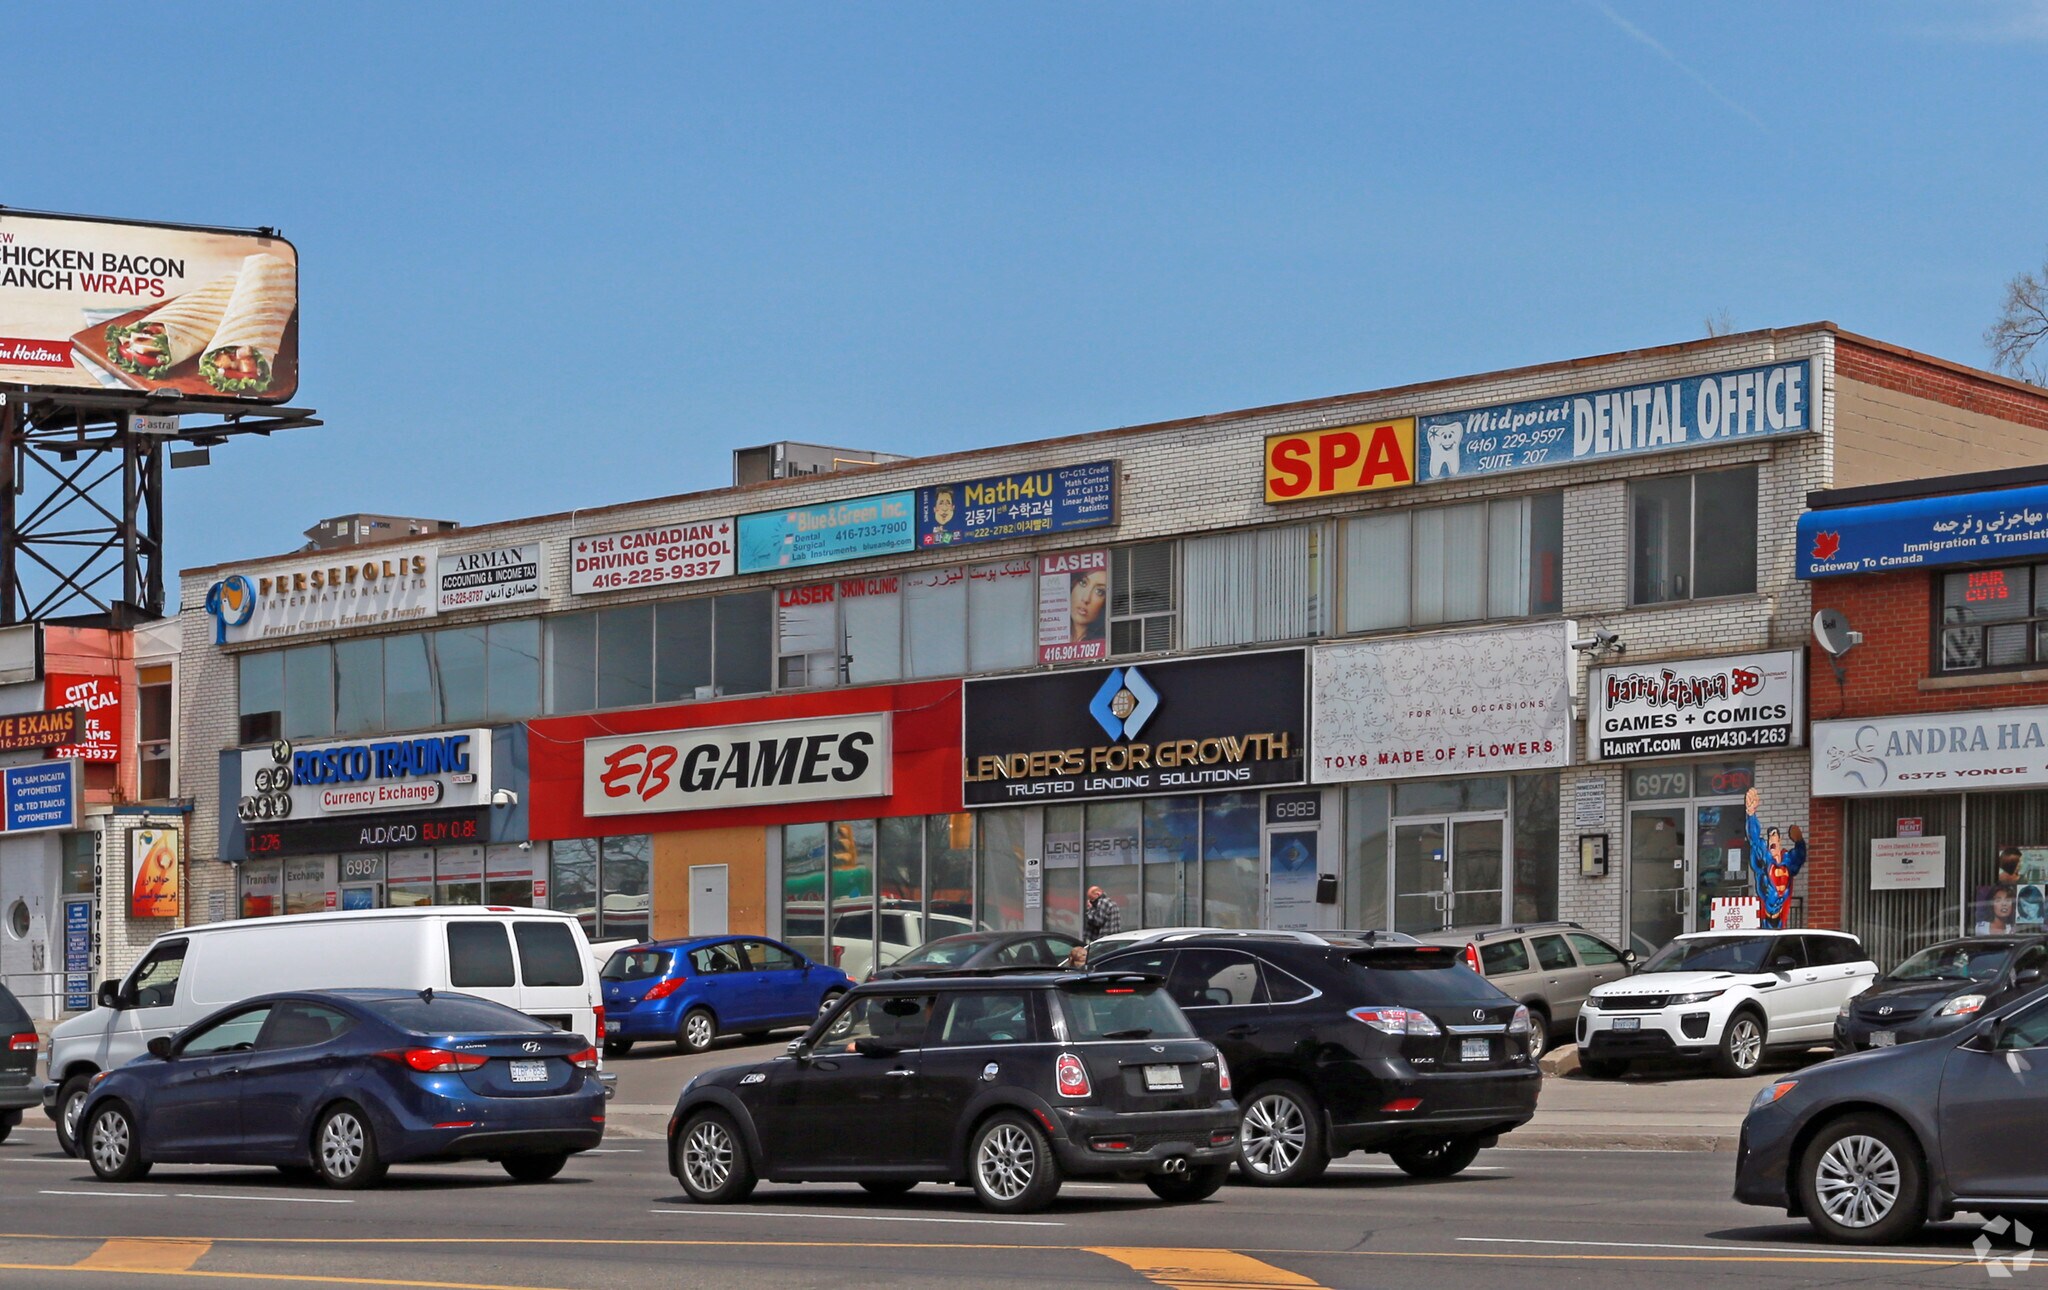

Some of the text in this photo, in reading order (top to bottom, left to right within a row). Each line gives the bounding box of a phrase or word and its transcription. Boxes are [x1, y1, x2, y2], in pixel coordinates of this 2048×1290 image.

[0, 245, 185, 279] HICKEN BACON
[0, 267, 165, 298] ANCH WRAPS
[1466, 401, 1571, 434] Midpoint
[1573, 366, 1802, 457] DENTAL OFFICE
[147, 419, 174, 430] astral
[1465, 427, 1566, 455] (416) 229-9597
[1268, 425, 1412, 499] SPA
[1477, 447, 1548, 471] SUITE 207
[1088, 466, 1109, 475] Credit
[964, 473, 1053, 507] Math4U
[1065, 475, 1109, 488] Math Contest
[1082, 486, 1093, 495] Cal
[1062, 494, 1109, 506] Linear Algebra
[1078, 503, 1109, 514] Statistics
[797, 499, 907, 532] Blue&Green Inc.
[965, 499, 1053, 526] 김동기 수학교실
[794, 521, 907, 542] Dental 416-733-7900
[1932, 514, 1972, 535] ترجمه
[591, 524, 714, 553] 1st CANADIAN
[793, 540, 826, 552] Surgical
[1903, 536, 1976, 553] Immigration
[1980, 534, 1990, 545] &
[456, 547, 523, 571] ARMAN
[576, 540, 731, 573] DRIVING SCHOOL
[792, 538, 912, 561] Lab Instruments blueandg.com
[1044, 552, 1105, 573] LASER
[1810, 553, 1923, 574] Gateway To Canada
[259, 555, 427, 597] PERSEPOLIS
[443, 565, 536, 589] ACCOUNTING & INCOME TAX
[592, 560, 721, 588] 416-225-9337
[1968, 571, 2005, 588] HAIR
[262, 584, 389, 611] INTERNATIONAL
[778, 575, 898, 608] LASER SKIN CLINIC
[1966, 585, 2009, 602] CUTS
[263, 605, 427, 636] Foreign Currency Exchange & Transfer
[1822, 618, 1837, 631] Bell
[1044, 642, 1101, 661] 416.901.7097
[65, 680, 99, 701] CITY
[1409, 700, 1545, 718] FOR ALL OCCASIONS
[1605, 714, 1678, 733] GAMES
[1703, 704, 1787, 725] COMICS
[0, 711, 74, 738] YE EXAMS
[85, 719, 99, 730] YE
[0, 732, 67, 749] 16-225-3937
[1690, 727, 1787, 751] (647)430-1263
[56, 748, 118, 759] 225-3937
[293, 734, 470, 786] ROSCO TRADING
[964, 732, 1289, 782] LENDERS FOR GROWTH
[1325, 740, 1553, 769] TOYS MADE OF FLOWERS
[600, 731, 874, 802] EB GAMES
[1898, 766, 2028, 781] 6375 YONGE
[12, 776, 25, 786] DR.
[25, 774, 39, 784] SAM
[1005, 767, 1250, 797] TRUSTED LENDING SOLUTIONS
[1635, 773, 1687, 797] 6979
[1711, 772, 1751, 790] OPEN
[17, 785, 63, 797] OPTOMETRIST
[324, 782, 435, 806] Currency Exchange
[14, 803, 25, 812] DR.
[26, 801, 39, 810] TED
[17, 811, 63, 823] OPTOMETRIST
[1275, 801, 1316, 818] 6983
[360, 823, 447, 845] AUD/CAD BUY
[1899, 824, 1920, 832] RENT
[1045, 839, 1112, 855] LENDERS
[1113, 838, 1139, 850] FOR
[346, 858, 379, 876] 6987
[245, 871, 325, 886] Transfer Exchange
[1724, 915, 1744, 924] BARBER
